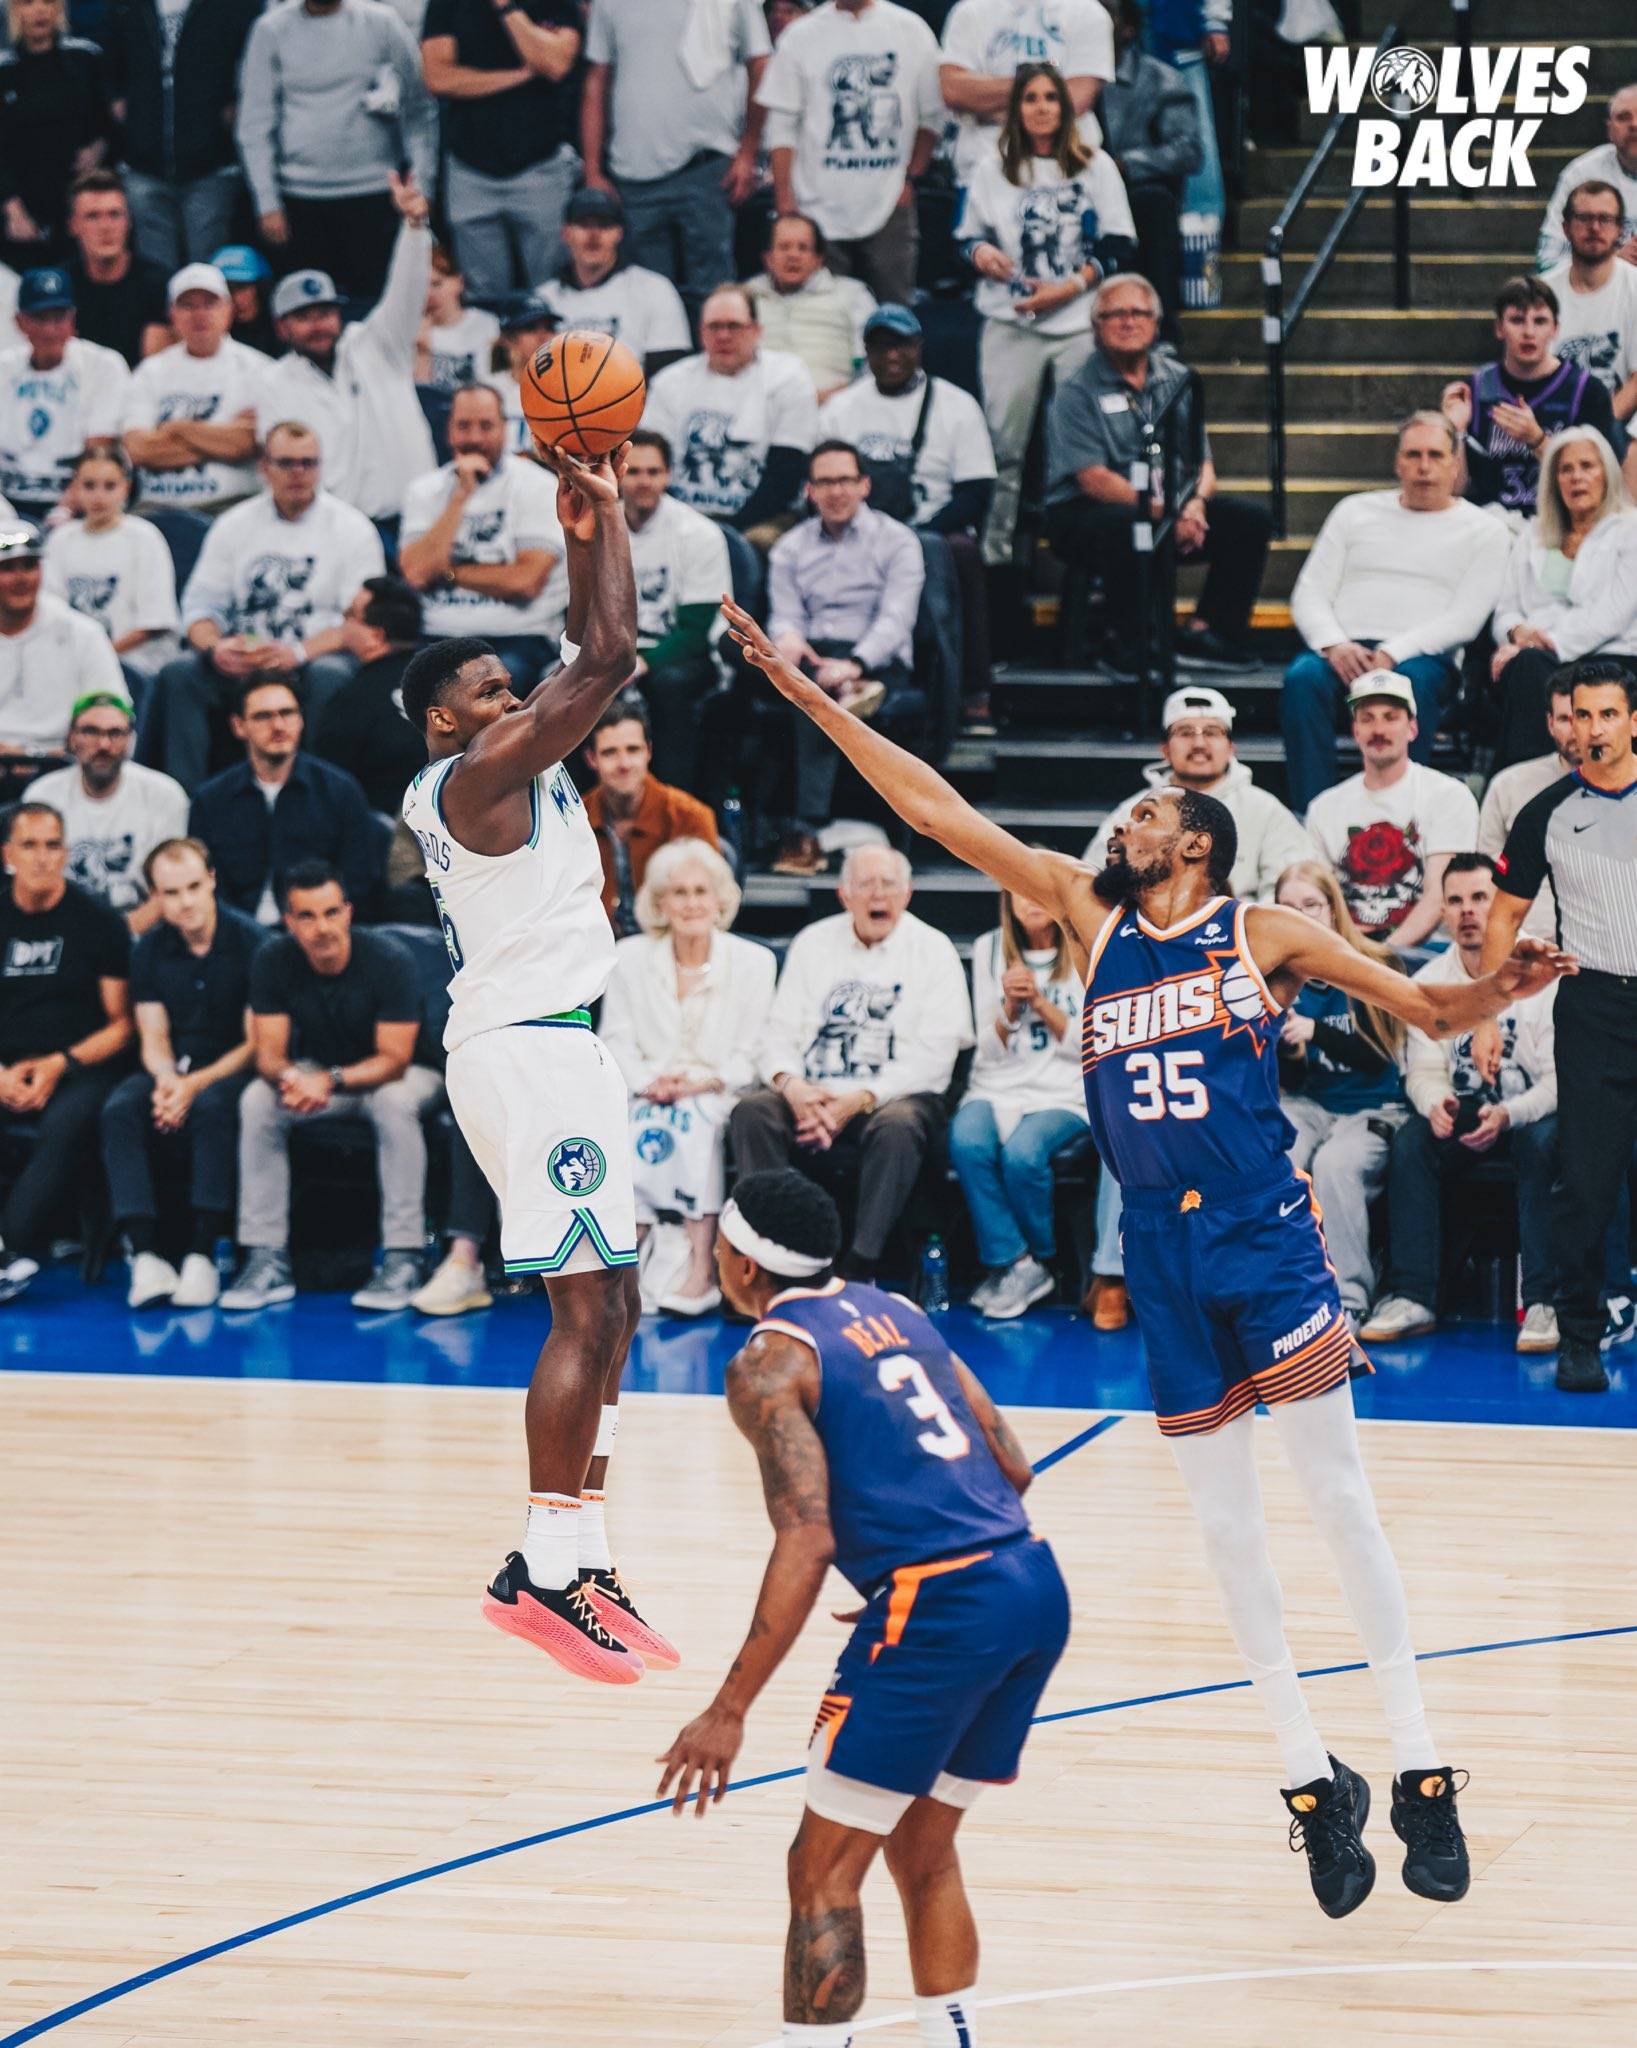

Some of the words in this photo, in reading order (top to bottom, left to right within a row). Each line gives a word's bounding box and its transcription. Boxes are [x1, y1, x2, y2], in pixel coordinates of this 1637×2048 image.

[1194, 935, 1228, 945] PayPal
[1093, 974, 1216, 1055] SUNS
[1125, 1050, 1210, 1121] 35
[841, 1312, 911, 1358] BEAL
[1272, 1302, 1333, 1360] PHOENIX
[877, 1353, 971, 1461] 3
